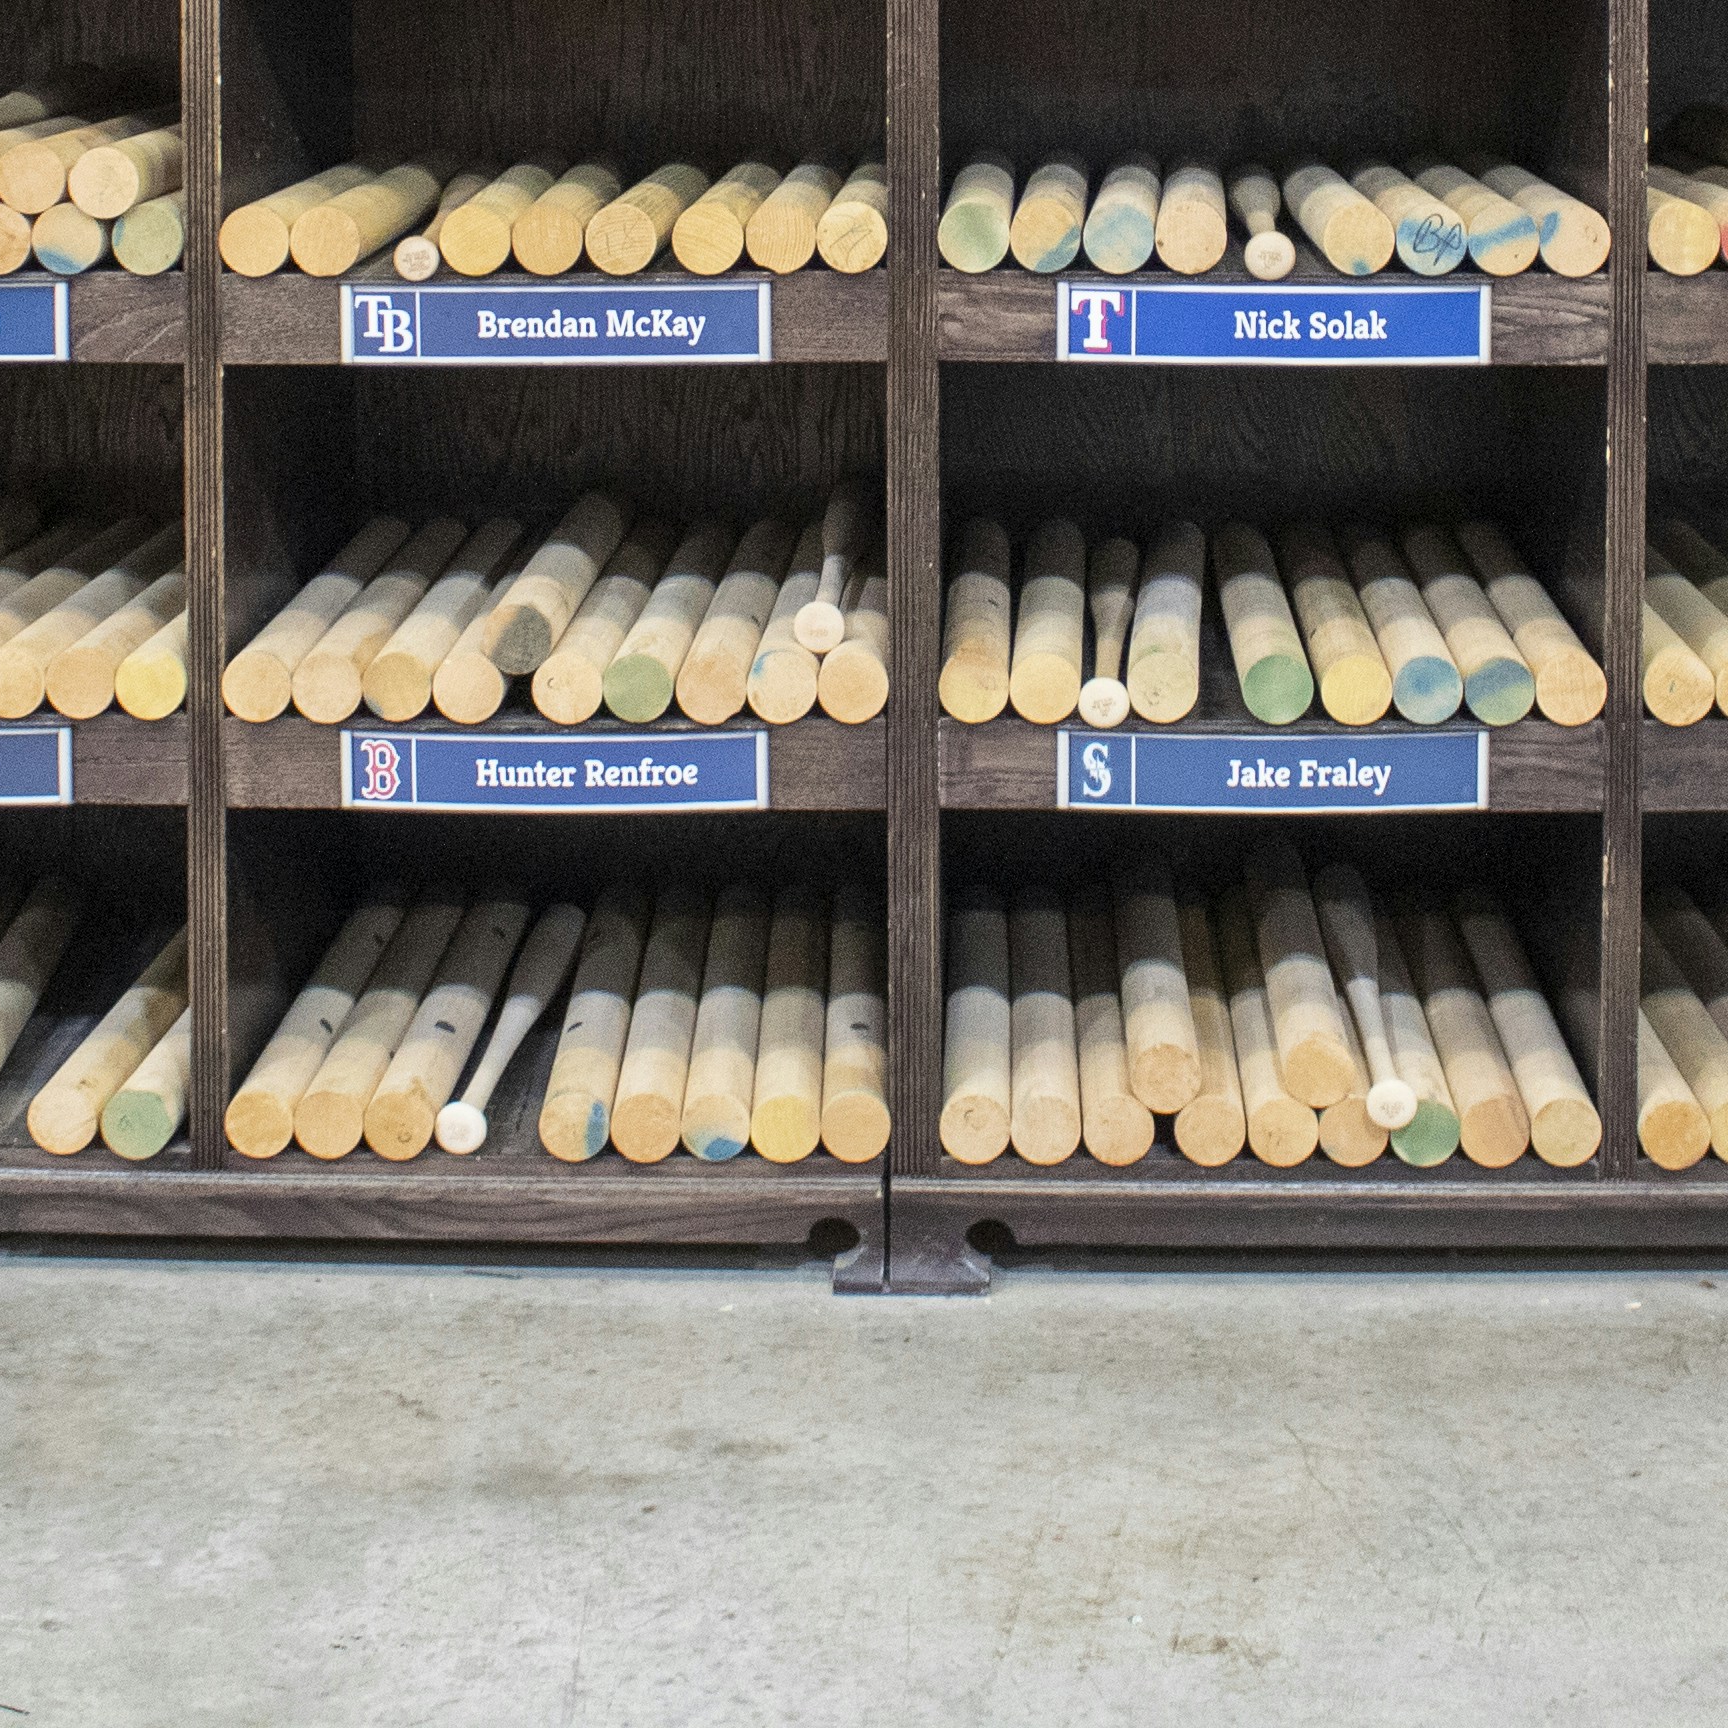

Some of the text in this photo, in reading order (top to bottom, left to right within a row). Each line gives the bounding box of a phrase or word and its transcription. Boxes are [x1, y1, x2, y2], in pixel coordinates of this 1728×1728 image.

[355, 294, 413, 352] TB
[478, 309, 705, 346] Brendan McKay
[1072, 292, 1123, 352] T
[1234, 310, 1387, 339] Nick Solak
[361, 739, 400, 798] B
[476, 758, 698, 787] Hunter Renfroe
[1083, 743, 1111, 798] S
[1227, 758, 1391, 795] Jake Fraley
